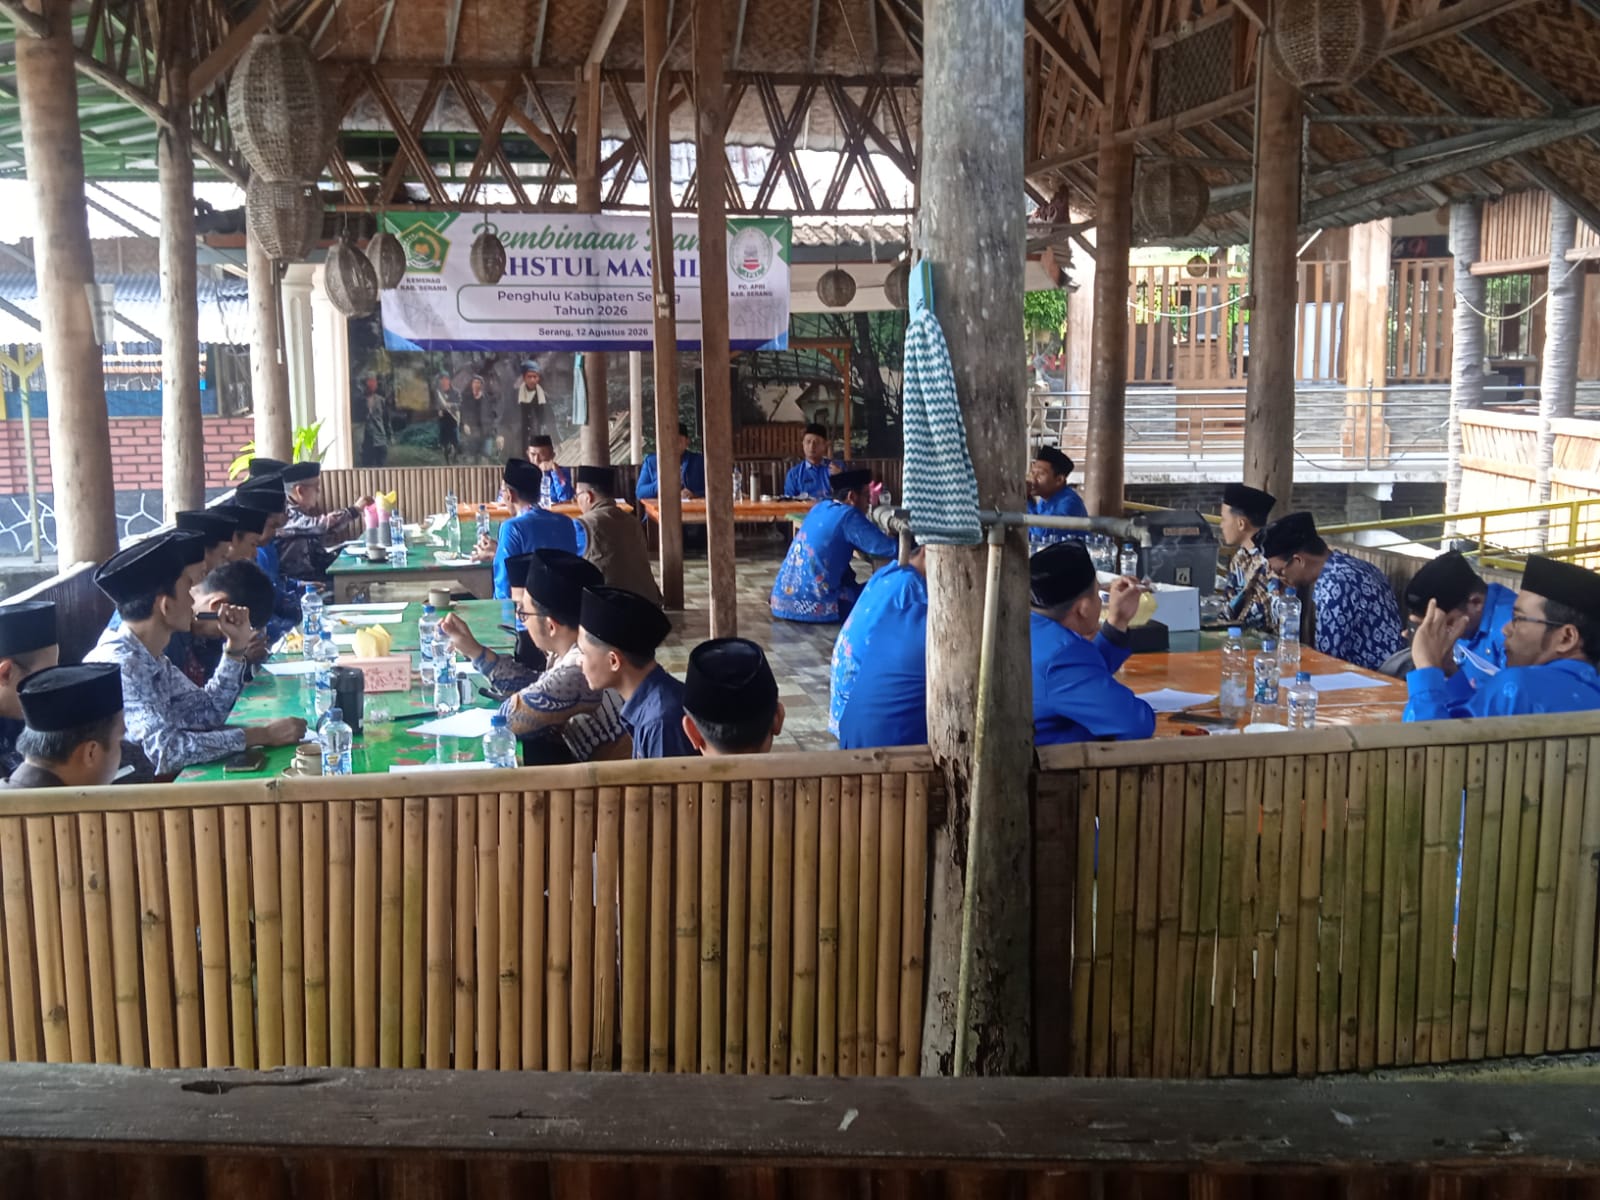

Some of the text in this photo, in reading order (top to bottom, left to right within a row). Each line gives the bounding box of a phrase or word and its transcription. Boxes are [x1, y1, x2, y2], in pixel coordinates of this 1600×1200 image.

[497, 290, 560, 304] Penghulu
[564, 290, 635, 304] Kabupaten
[553, 305, 628, 317] Tahun 2026
[538, 327, 649, 338] Serang, 12 Agustus 2026
